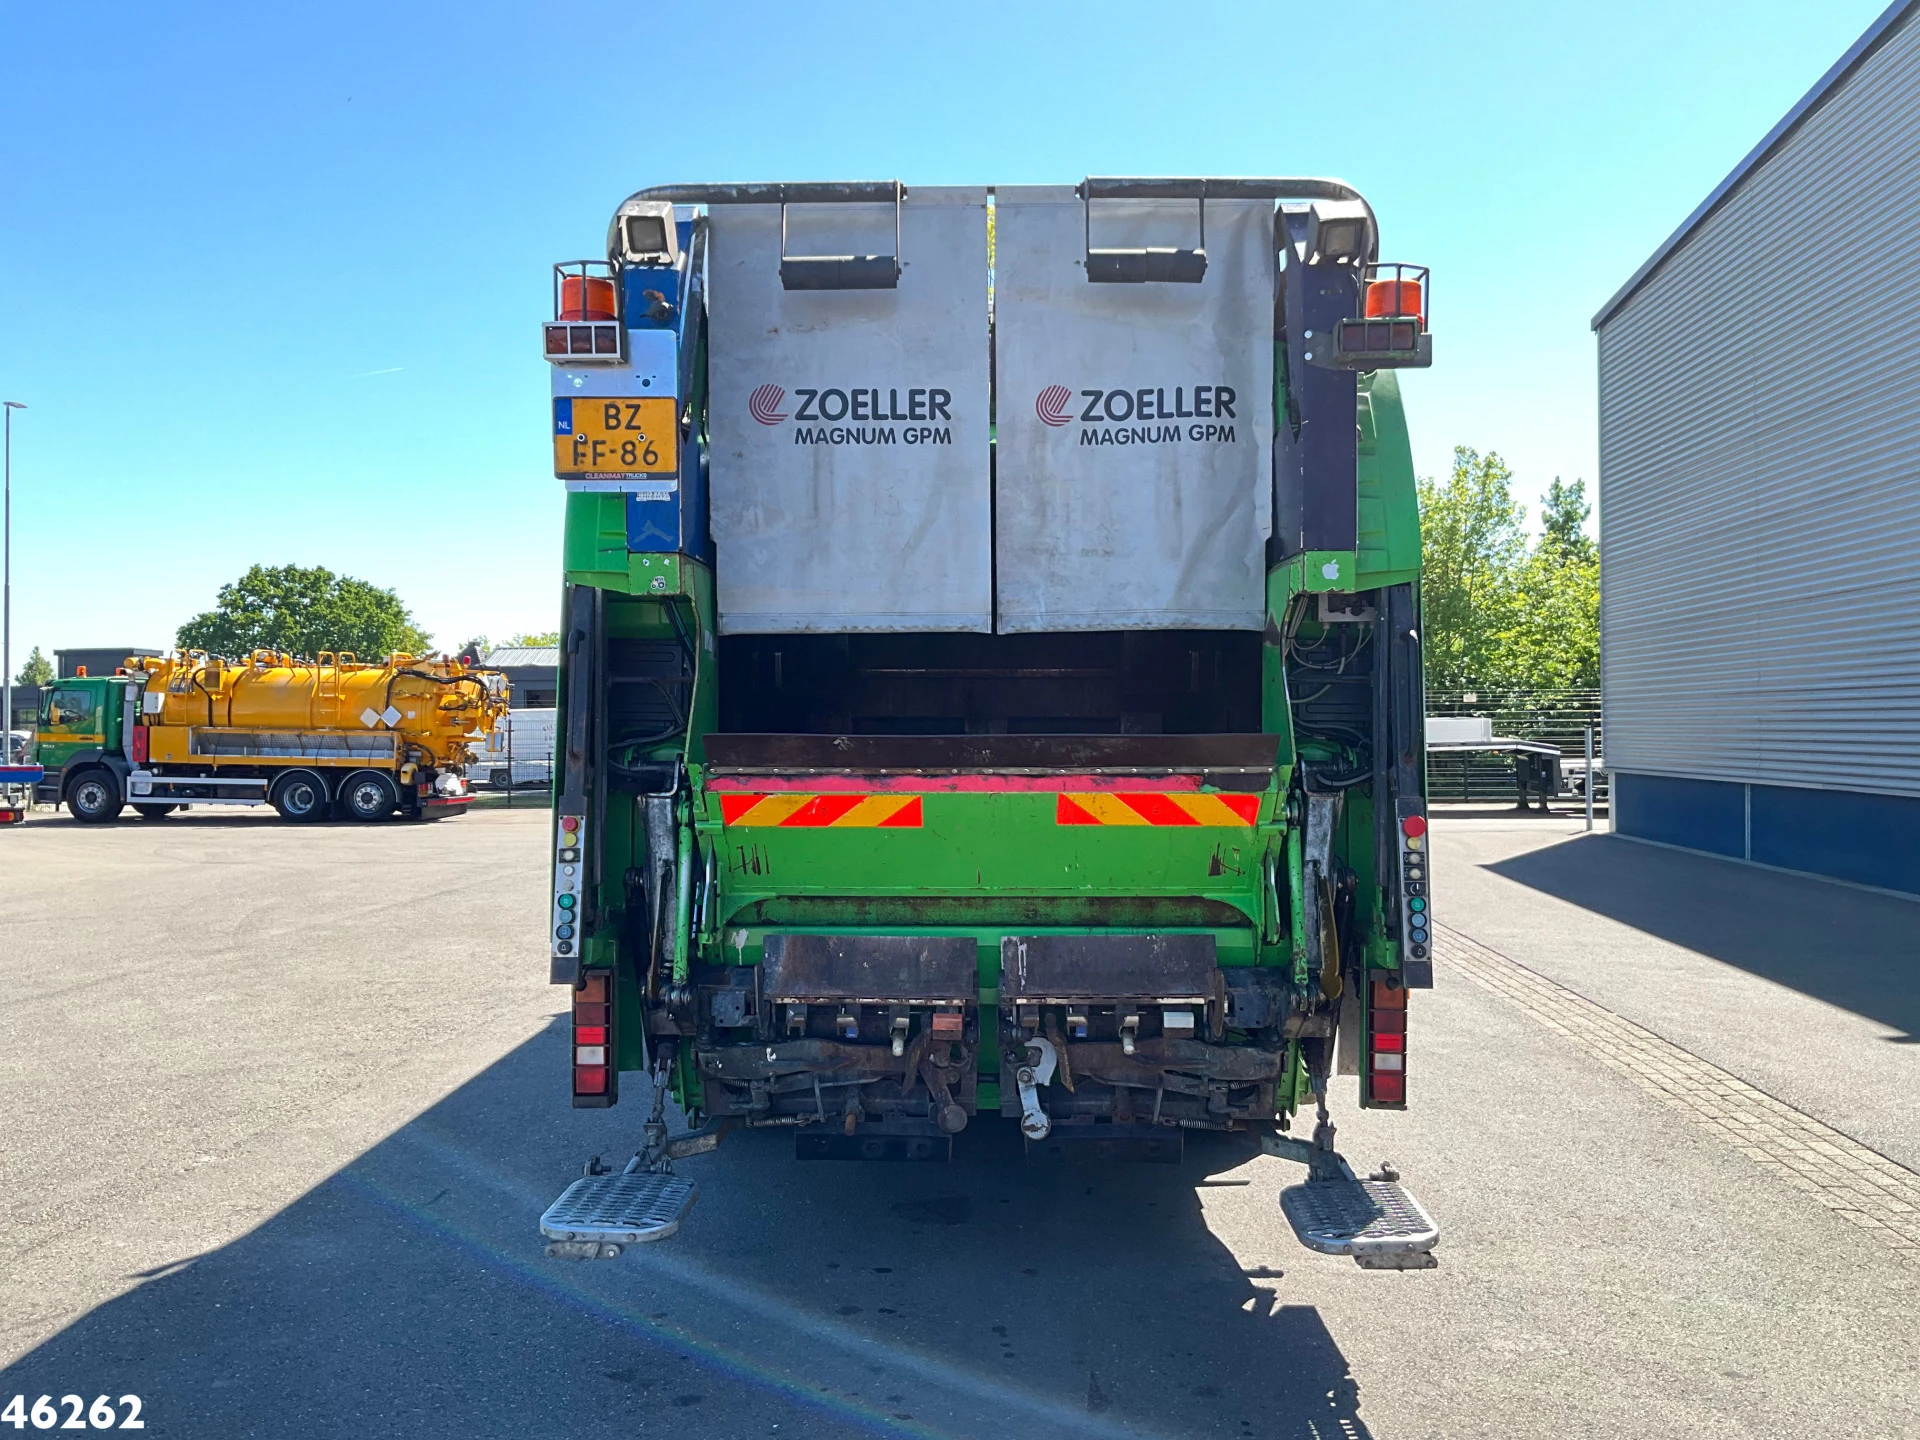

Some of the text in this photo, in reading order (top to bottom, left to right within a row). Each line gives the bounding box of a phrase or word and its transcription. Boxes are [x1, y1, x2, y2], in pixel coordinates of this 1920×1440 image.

[604, 403, 642, 430] BZ
[794, 388, 952, 421] ZOELLER
[1080, 385, 1236, 422] ZOELLER
[558, 420, 571, 430] NL
[794, 427, 952, 445] MAGNUM GPM
[1080, 424, 1236, 446] MAGNUM GPM
[573, 439, 659, 466] FF-86
